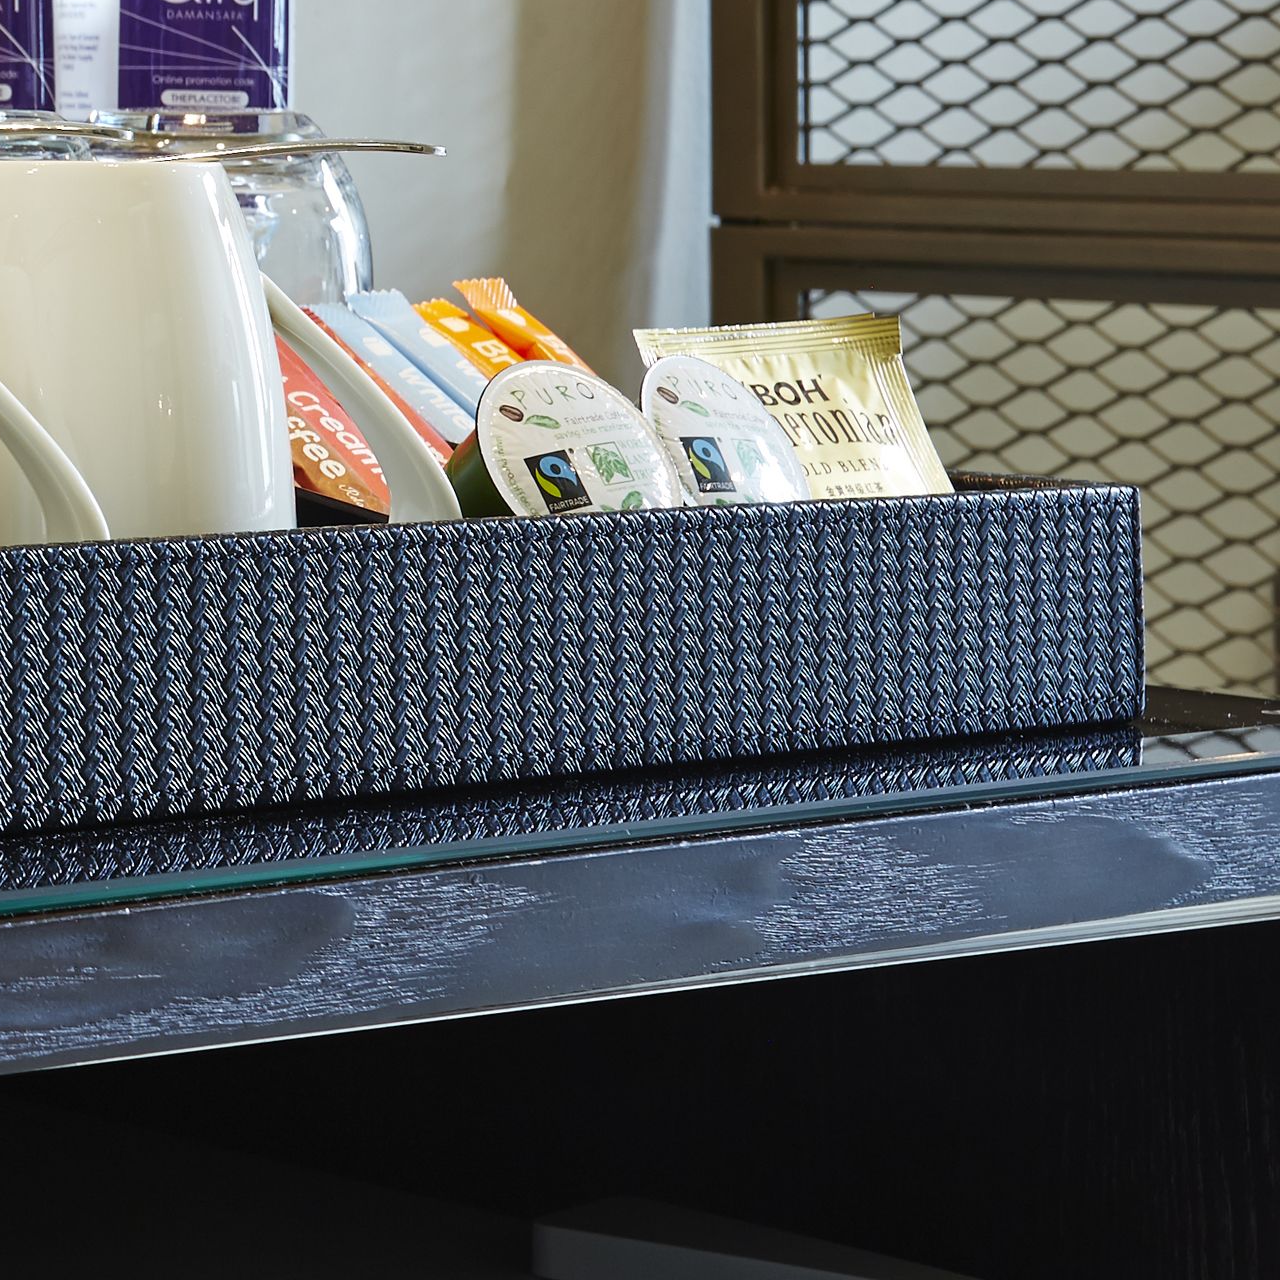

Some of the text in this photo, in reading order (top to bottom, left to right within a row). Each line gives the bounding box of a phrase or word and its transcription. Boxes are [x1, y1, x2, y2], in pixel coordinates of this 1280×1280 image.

[166, 8, 245, 21] DAMANSARA
[185, 76, 232, 88] promotion
[510, 382, 594, 410] PURO
[287, 390, 387, 486] Cream
[549, 496, 590, 512] FAIRTRADE
